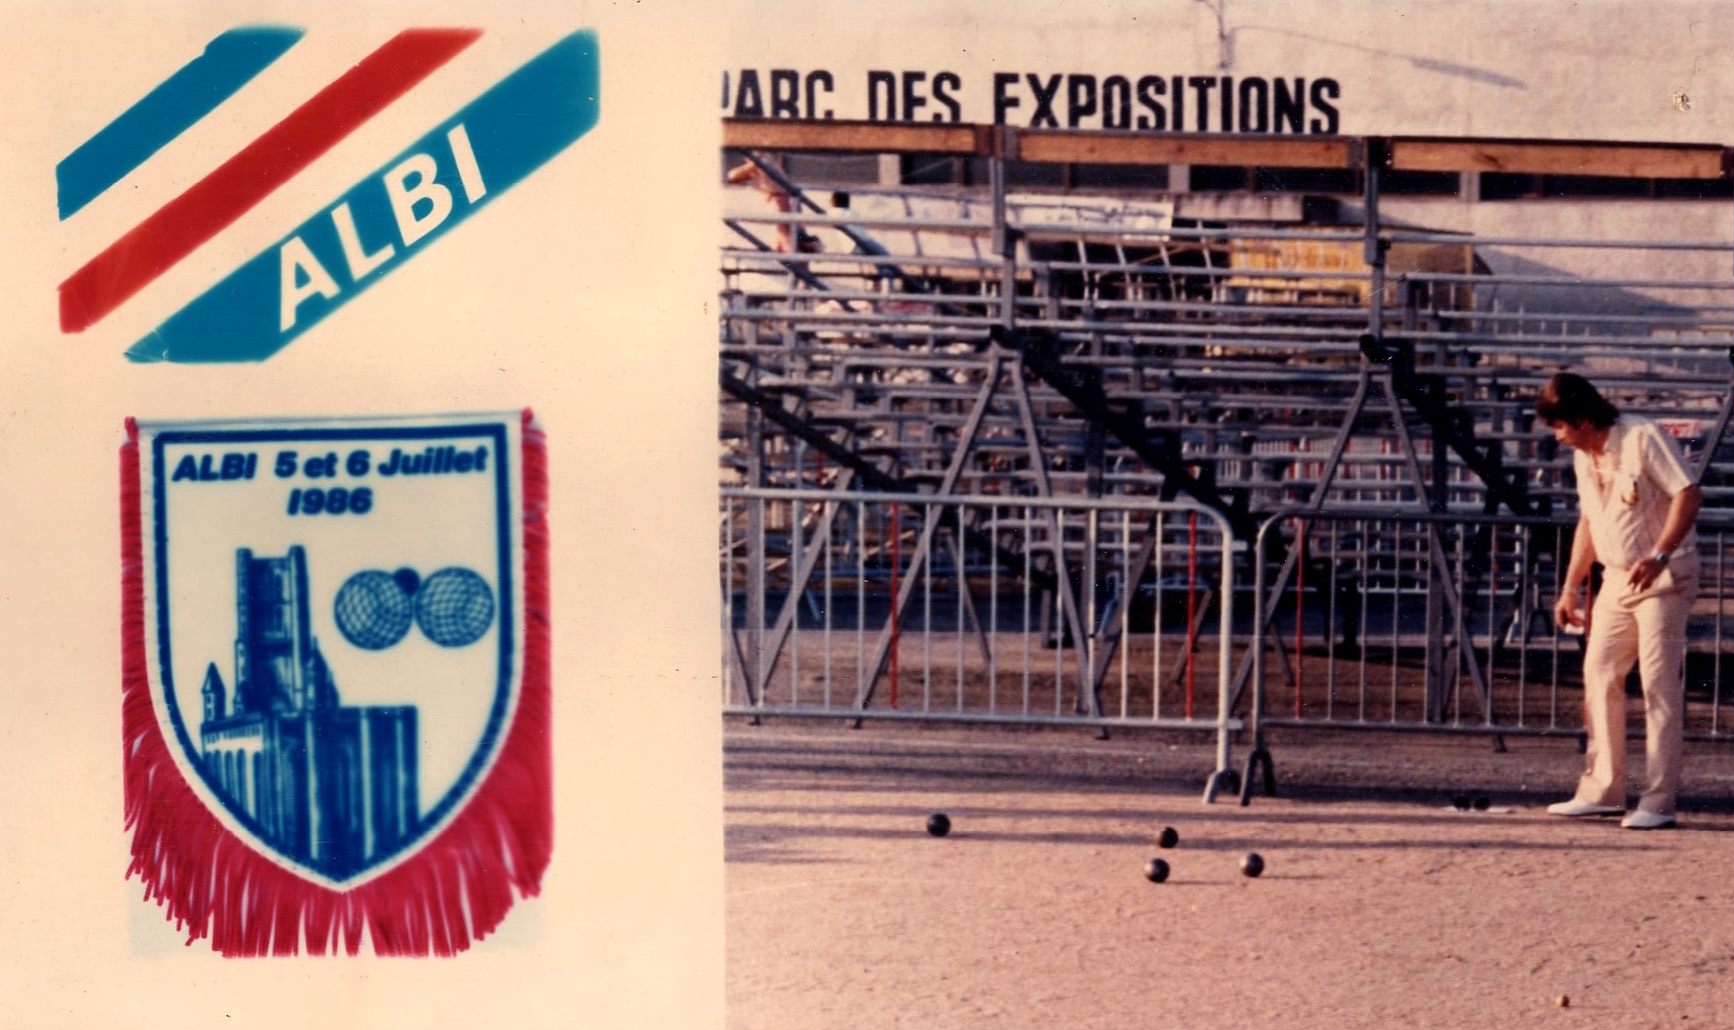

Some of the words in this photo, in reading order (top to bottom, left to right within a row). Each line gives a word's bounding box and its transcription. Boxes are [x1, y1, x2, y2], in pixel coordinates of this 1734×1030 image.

[721, 68, 834, 120] ARC
[868, 70, 961, 122] DES
[994, 72, 1341, 135] EXPOSITIONS
[171, 451, 258, 483] ALBI
[274, 450, 298, 480] 5
[302, 450, 339, 480] et
[345, 449, 372, 479] 6
[377, 445, 490, 479] Juillet
[285, 486, 375, 517] 1986
